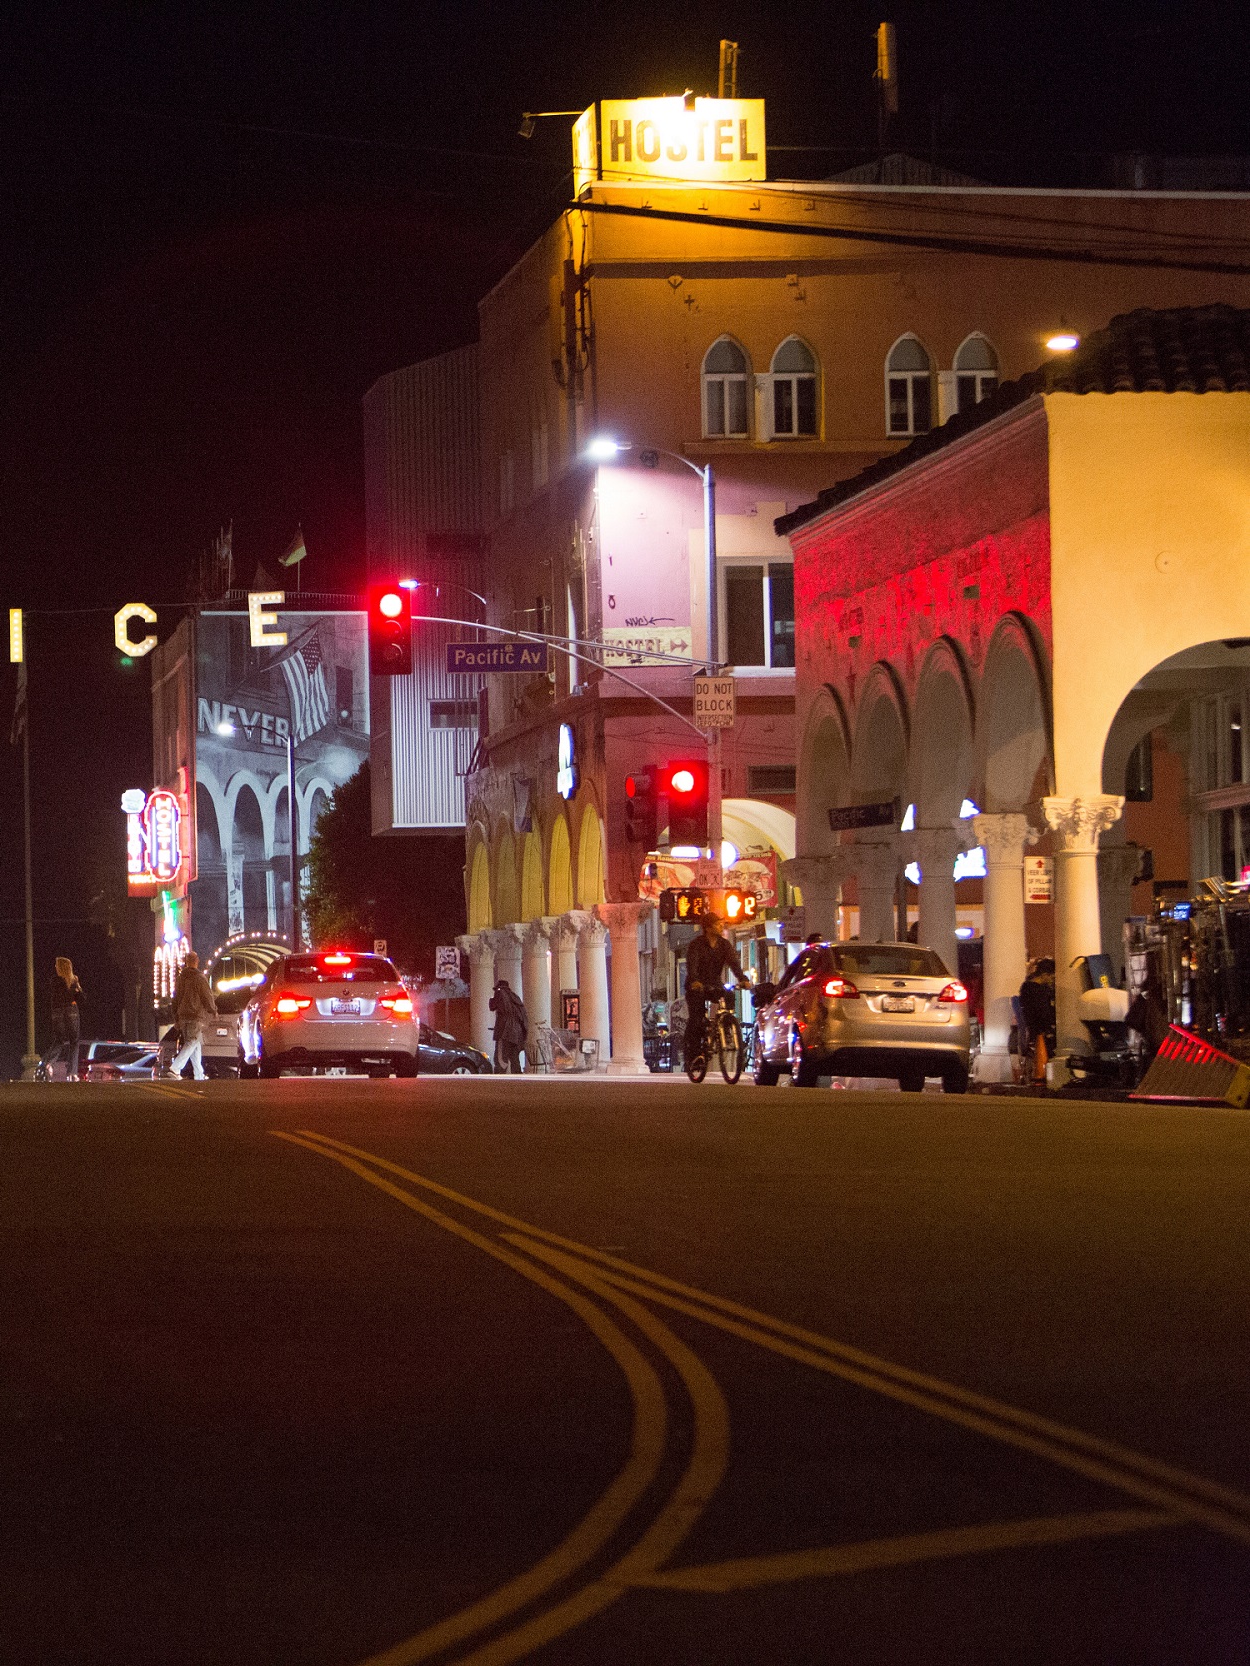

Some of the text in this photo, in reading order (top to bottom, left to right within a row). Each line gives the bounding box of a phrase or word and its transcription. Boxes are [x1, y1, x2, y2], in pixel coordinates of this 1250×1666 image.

[610, 119, 758, 162] HOSTEL
[455, 649, 542, 665] Pacific Av
[696, 683, 732, 695] DO NOT
[696, 699, 732, 711] BLOCK
